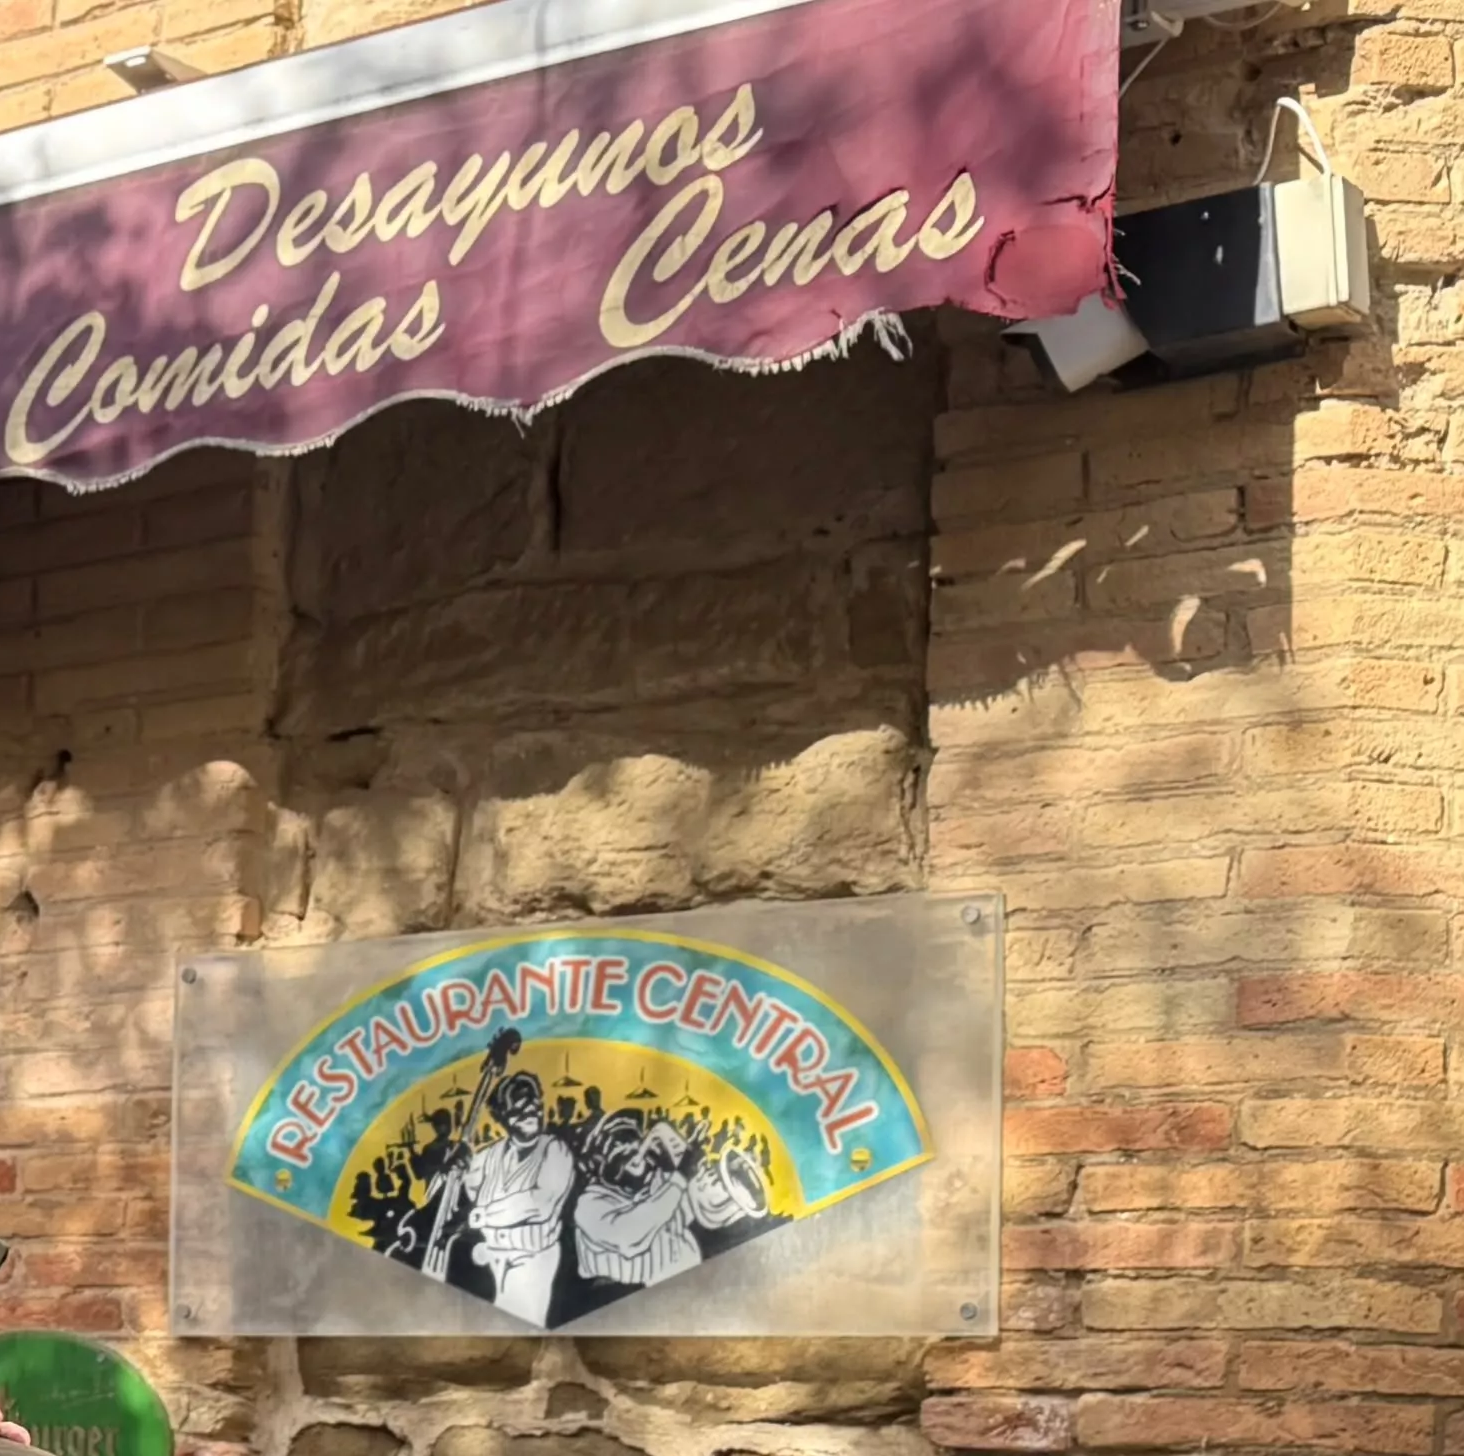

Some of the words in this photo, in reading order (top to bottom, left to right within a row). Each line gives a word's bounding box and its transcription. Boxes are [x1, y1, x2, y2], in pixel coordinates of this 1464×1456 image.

[174, 82, 764, 293] Desayunos
[3, 270, 446, 465] Comidas
[597, 170, 986, 349] Cenas
[266, 954, 628, 1169] RESTAURANTE
[633, 961, 880, 1156] CENTRAL
